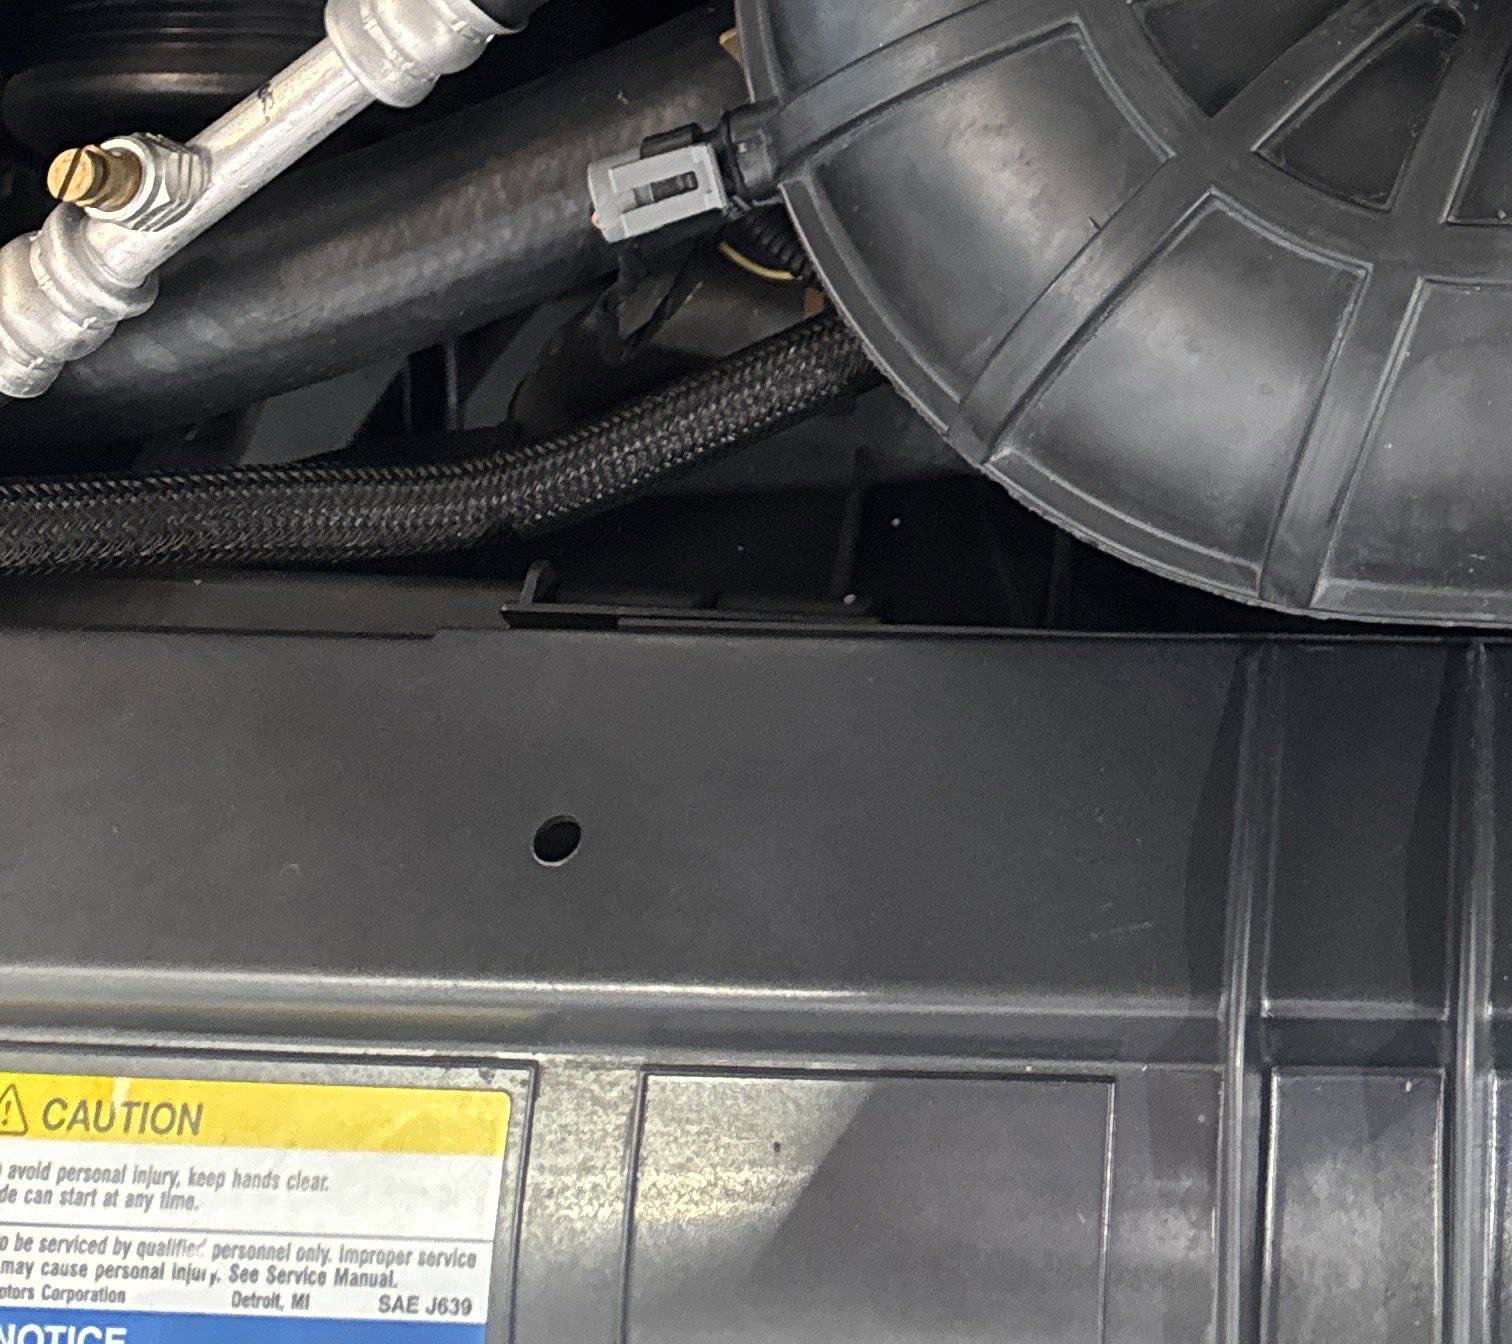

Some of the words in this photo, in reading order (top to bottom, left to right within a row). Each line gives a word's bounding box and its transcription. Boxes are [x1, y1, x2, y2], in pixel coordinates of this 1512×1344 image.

[42, 1096, 205, 1137] CAUTION
[7, 1160, 52, 1181] avoid
[55, 1164, 127, 1187] personal
[131, 1166, 181, 1190] injury,
[187, 1166, 227, 1192] keep
[231, 1168, 280, 1191] hands
[286, 1170, 329, 1192] clear.
[23, 1187, 53, 1206] can
[59, 1188, 97, 1208] start
[103, 1189, 119, 1208] at
[124, 1191, 155, 1214] any
[159, 1187, 200, 1212] time.
[13, 1232, 34, 1254] be
[38, 1234, 108, 1256] serviced
[112, 1236, 133, 1261] by
[211, 1241, 292, 1264] personnel
[295, 1243, 333, 1267] only.
[338, 1243, 413, 1269] Improper
[417, 1246, 478, 1269] service
[40, 1261, 89, 1278] cause
[94, 1261, 165, 1283] personal
[228, 1263, 260, 1285] See
[265, 1264, 327, 1288] Service
[333, 1267, 399, 1290] Manual.
[41, 1283, 126, 1305] Corporation
[231, 1291, 285, 1312] Detroit,
[291, 1293, 311, 1311] MI
[378, 1294, 420, 1315] SAE
[425, 1297, 473, 1317] J639
